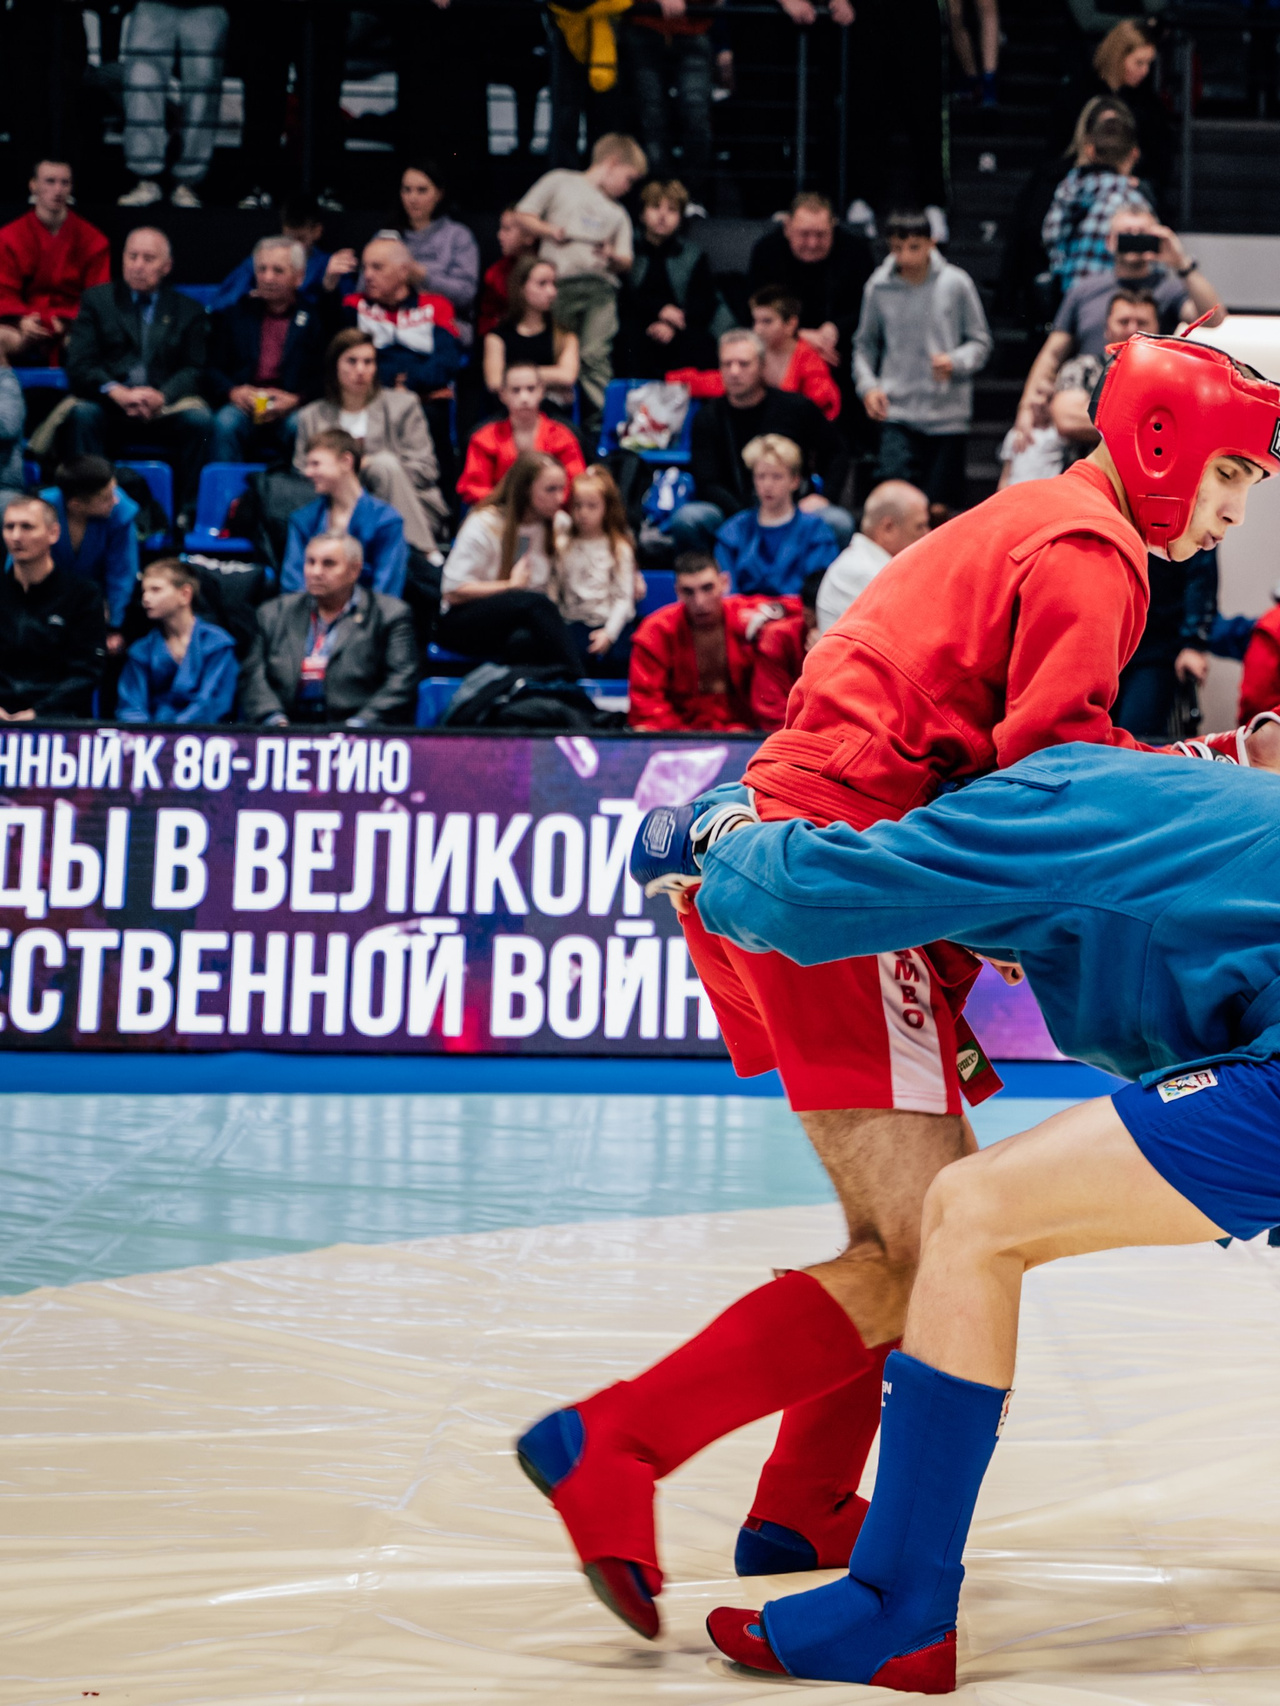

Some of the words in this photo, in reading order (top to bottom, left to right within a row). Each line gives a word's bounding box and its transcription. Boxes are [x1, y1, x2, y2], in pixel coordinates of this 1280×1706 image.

[132, 735, 165, 790] К
[172, 734, 411, 794] 80-ЛЕТИЮ
[0, 798, 129, 920] ДЫ
[152, 806, 208, 911] В
[232, 799, 645, 917] ВЕЛИКОЙ
[0, 917, 464, 1039] СТВЕННОЙ
